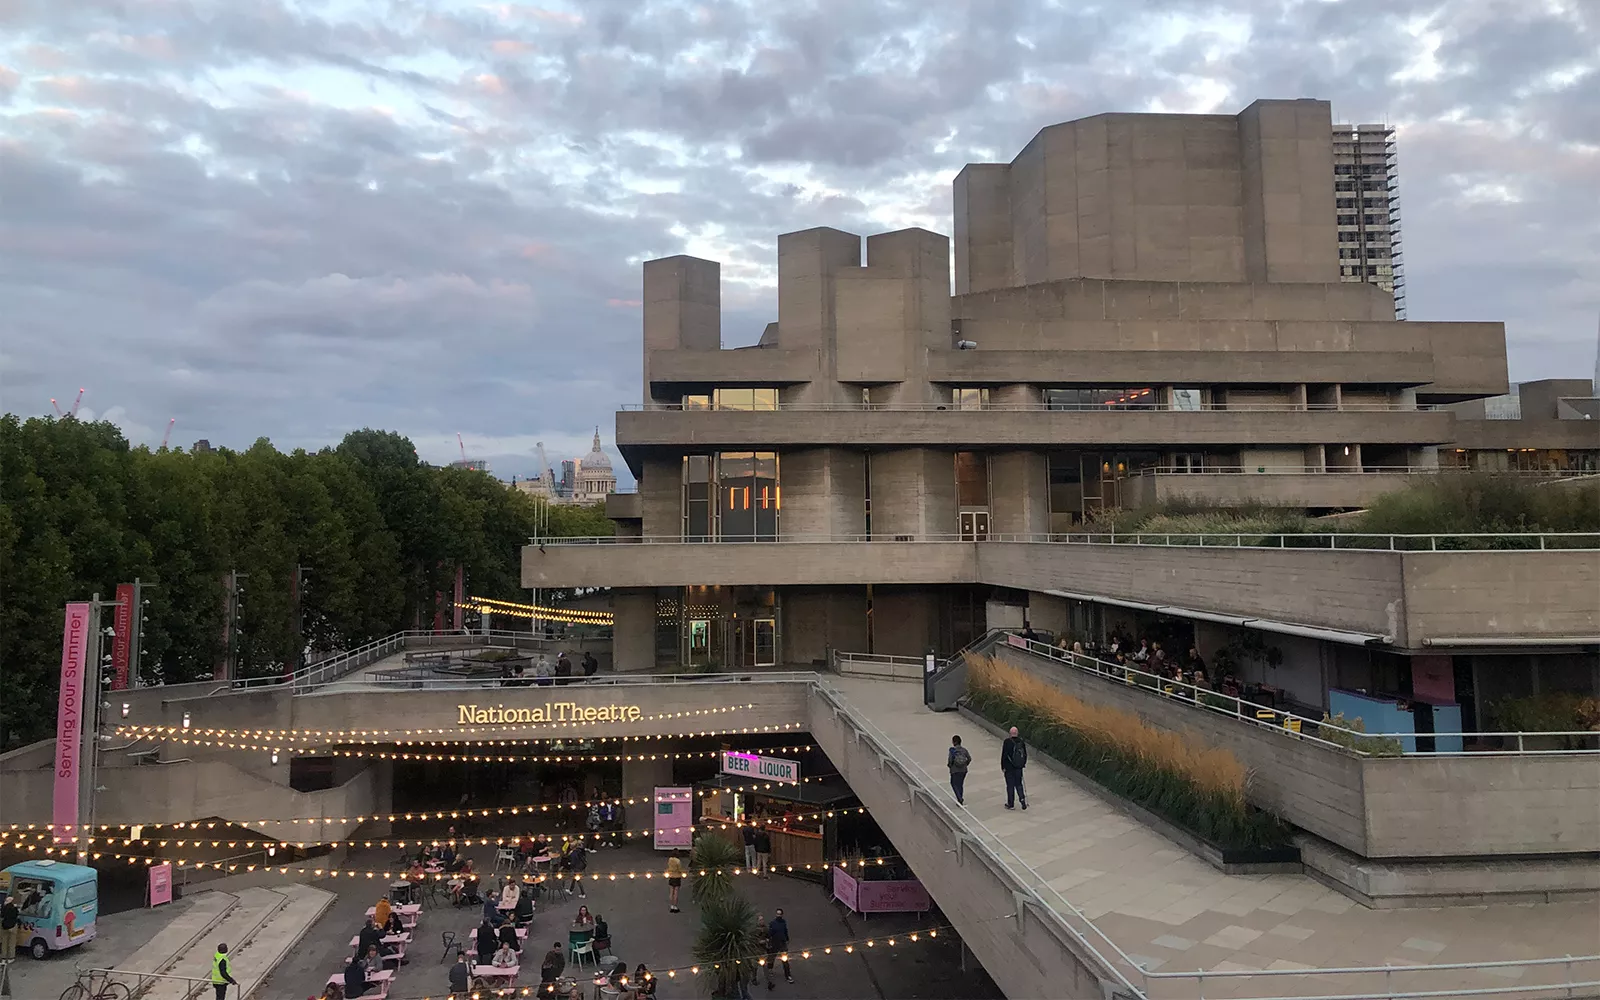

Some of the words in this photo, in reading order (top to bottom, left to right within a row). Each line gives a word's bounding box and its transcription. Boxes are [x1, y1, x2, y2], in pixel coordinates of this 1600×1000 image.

[64, 613, 82, 678] Summer
[64, 682, 76, 716] your
[457, 703, 553, 725] National
[553, 702, 642, 723] Theatre
[59, 720, 76, 778] Serving
[728, 756, 750, 772] BEER
[759, 761, 792, 779] LIQUOR
